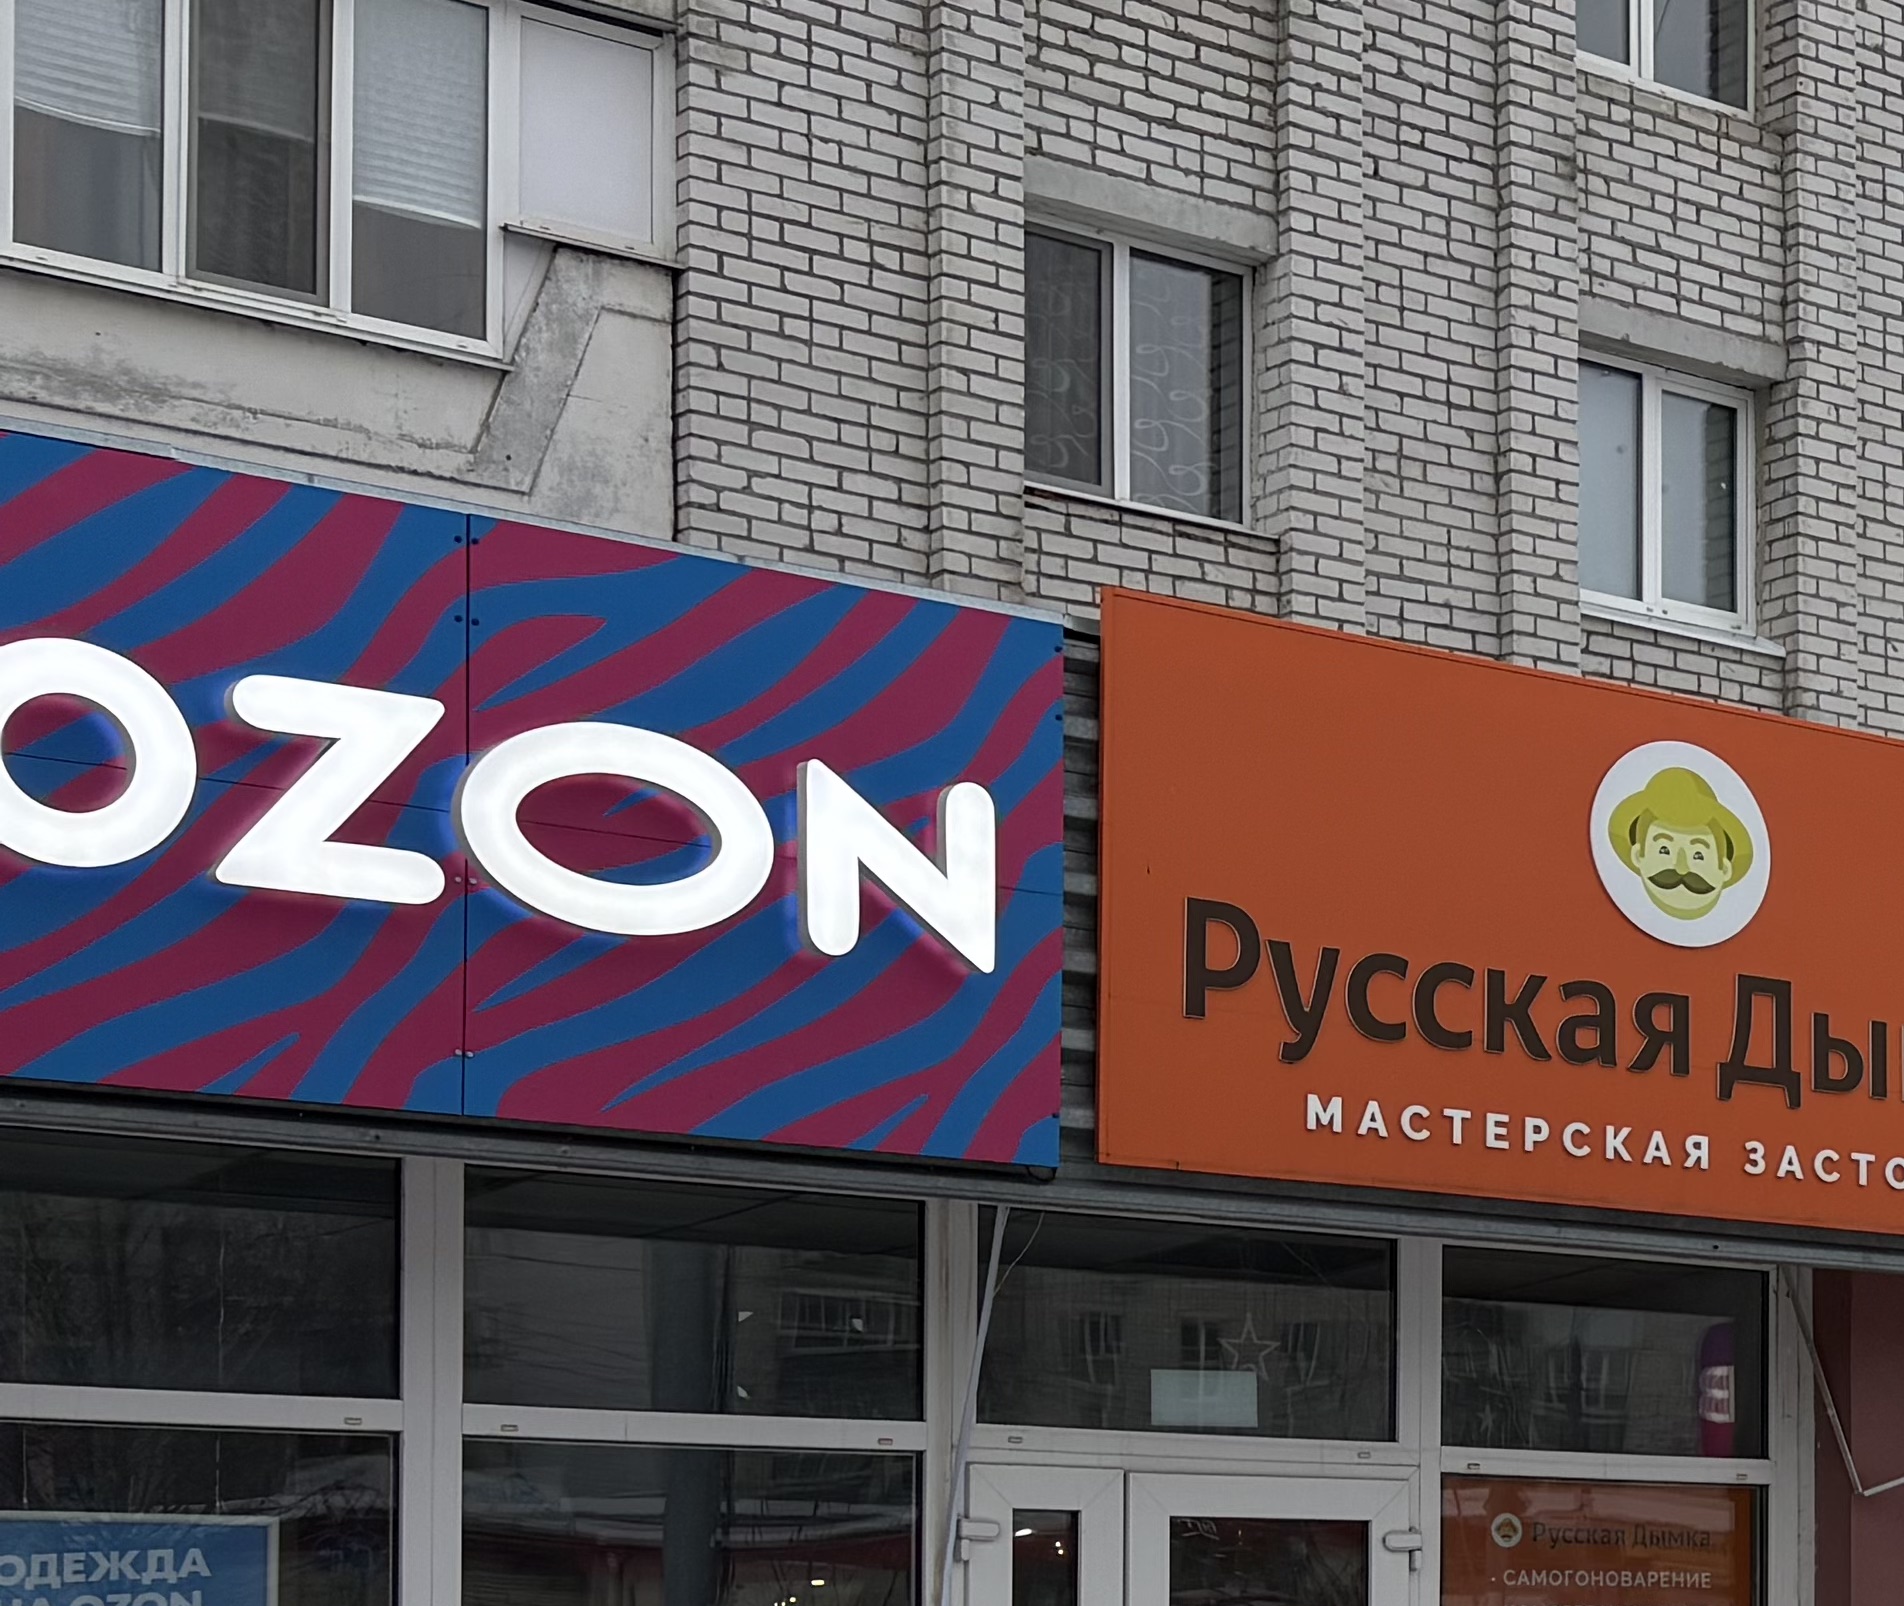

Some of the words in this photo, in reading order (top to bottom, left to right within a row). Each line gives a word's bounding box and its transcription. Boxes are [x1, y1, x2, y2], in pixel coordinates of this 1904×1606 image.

[0, 638, 995, 973] OZON
[1182, 897, 1692, 1077] Русская
[1305, 1093, 1711, 1170] МАСТЕРСКАЯ
[1532, 1522, 1625, 1550] Русская
[1632, 1524, 1711, 1549] Дымка
[0, 1548, 212, 1591] ОДЕЖДА
[1503, 1570, 1711, 1589] САМОГОНОВАРЕНИЕ
